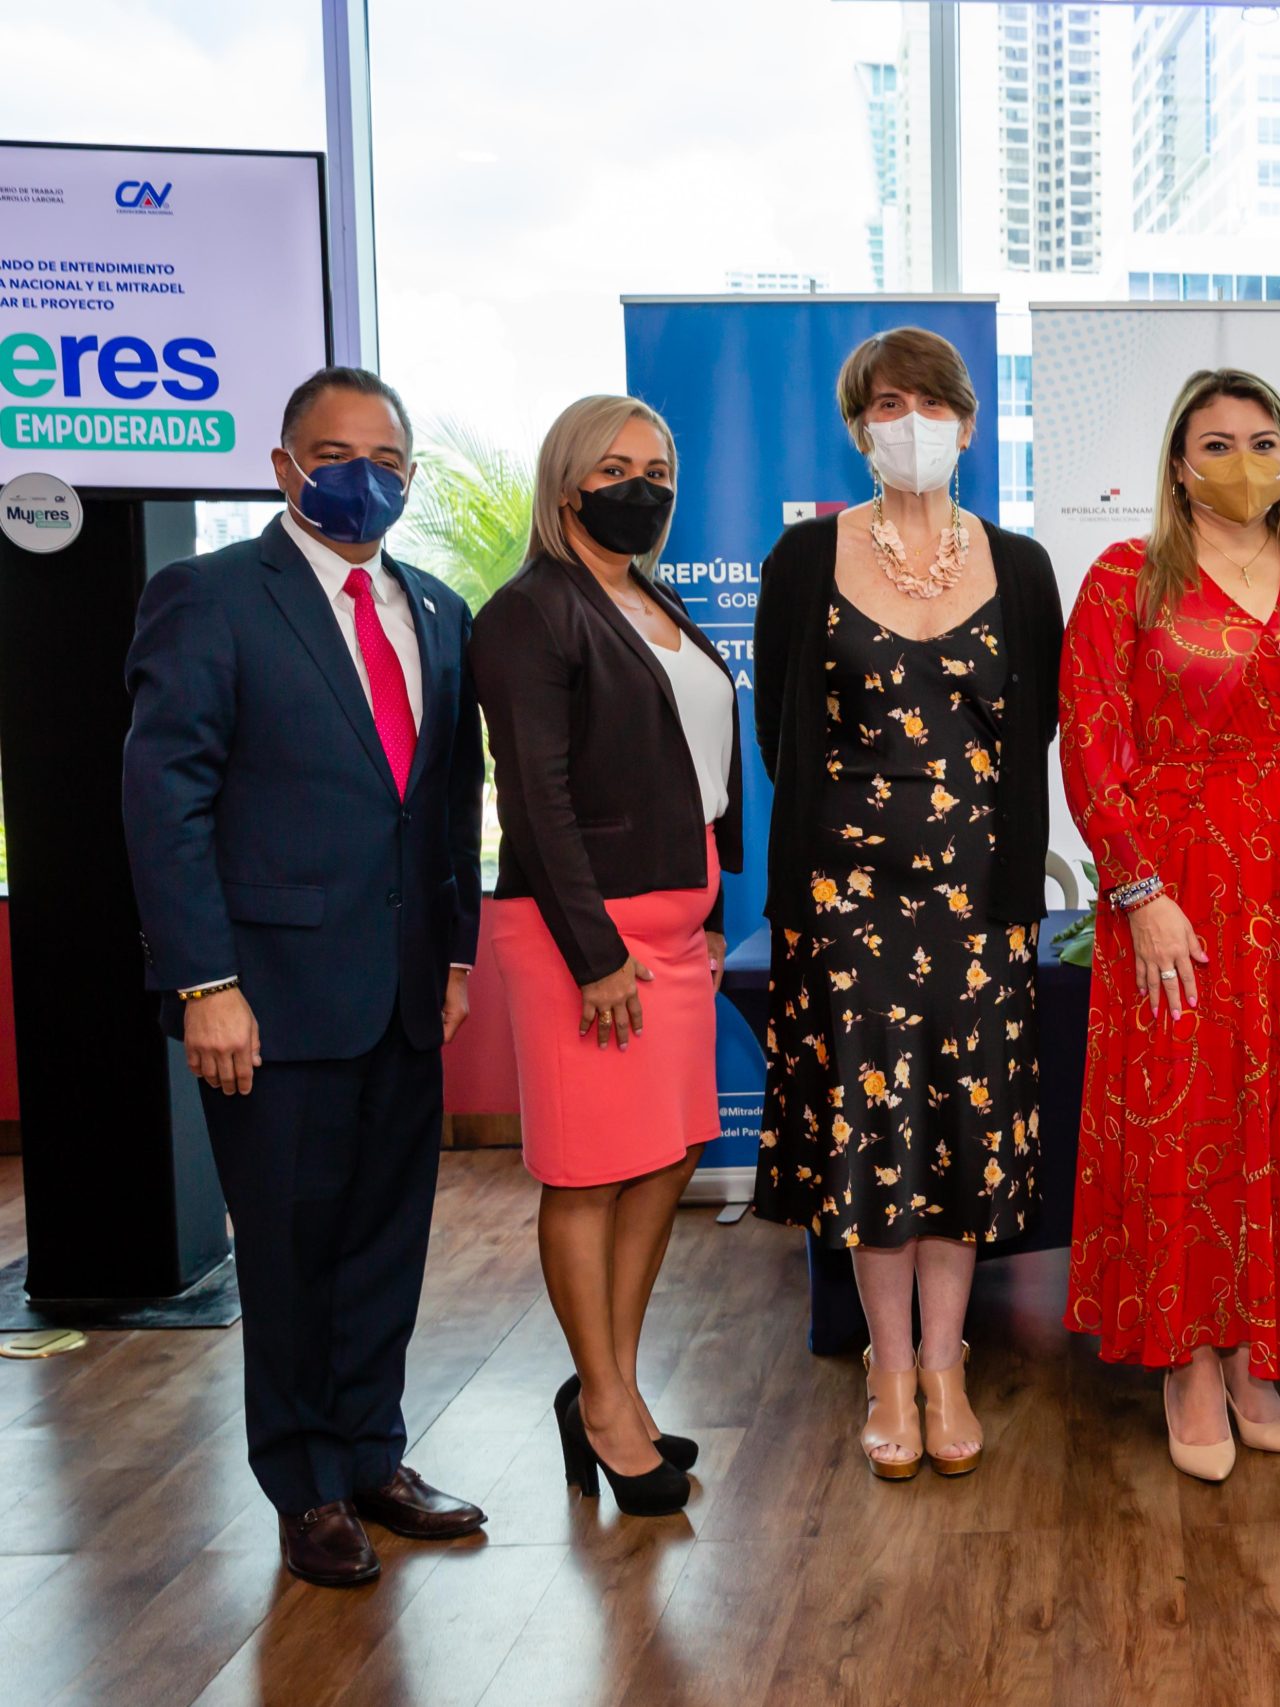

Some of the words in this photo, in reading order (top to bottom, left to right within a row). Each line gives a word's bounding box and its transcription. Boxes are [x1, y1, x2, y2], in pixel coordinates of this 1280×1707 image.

[0, 260, 34, 271] NDO
[38, 260, 56, 271] DE
[60, 261, 175, 275] ENTENDIMIENTO
[9, 279, 83, 291] NACIONAL
[86, 281, 95, 291] Y
[99, 281, 113, 292] EL
[116, 282, 185, 294] MITRADEL
[22, 297, 37, 309] EL
[41, 298, 114, 310] PROYECTO
[0, 332, 219, 401] eres
[15, 413, 221, 446] EMPODERADAS
[6, 506, 70, 524] Mujeres
[660, 557, 762, 584] REPÚBL
[717, 592, 758, 608] GOB
[711, 640, 754, 660] STE
